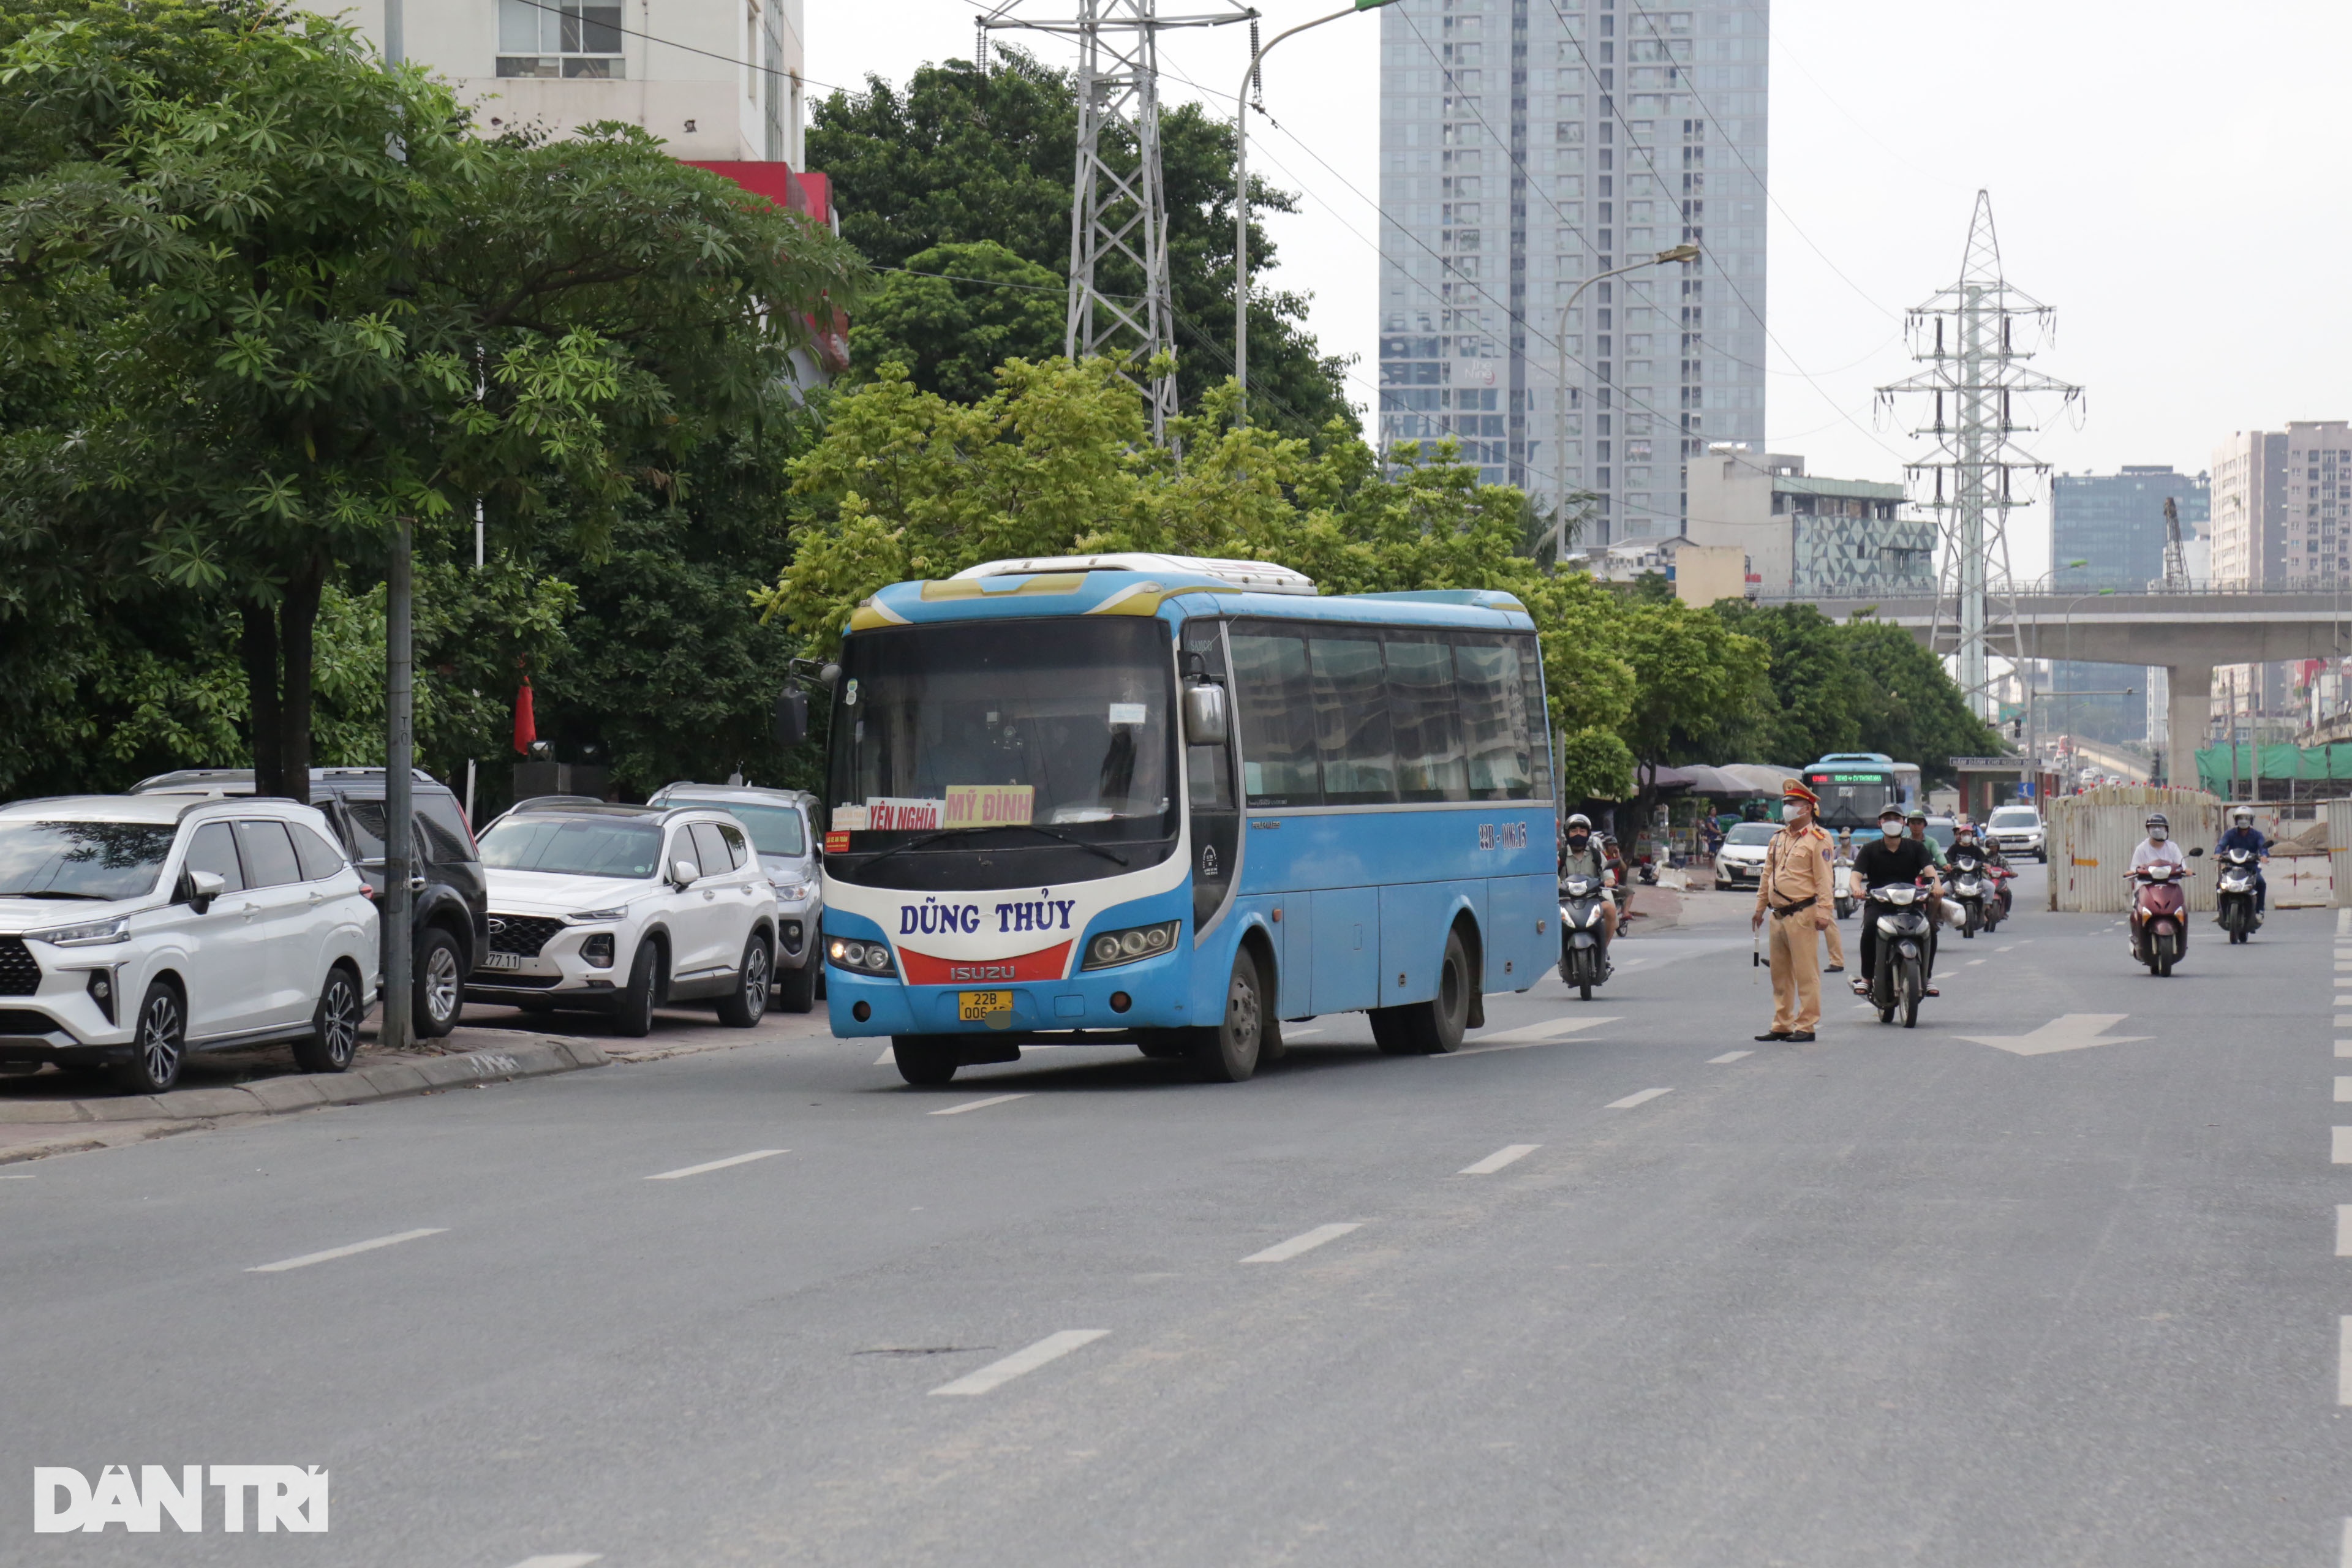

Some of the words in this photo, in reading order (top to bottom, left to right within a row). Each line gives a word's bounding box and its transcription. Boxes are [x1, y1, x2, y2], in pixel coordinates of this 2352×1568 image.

[1472, 359, 1493, 369] The
[946, 790, 978, 821] MỸ
[982, 788, 1032, 821] ĐÌNH
[870, 801, 895, 830] YÊN
[896, 802, 937, 830] NGHĨA
[1479, 824, 1495, 850] 22B
[899, 896, 980, 935] DŨNG
[995, 888, 1076, 933] THỦY
[484, 954, 518, 968] 77.11
[950, 965, 1016, 981] ISUZU
[974, 993, 997, 1005] 22B
